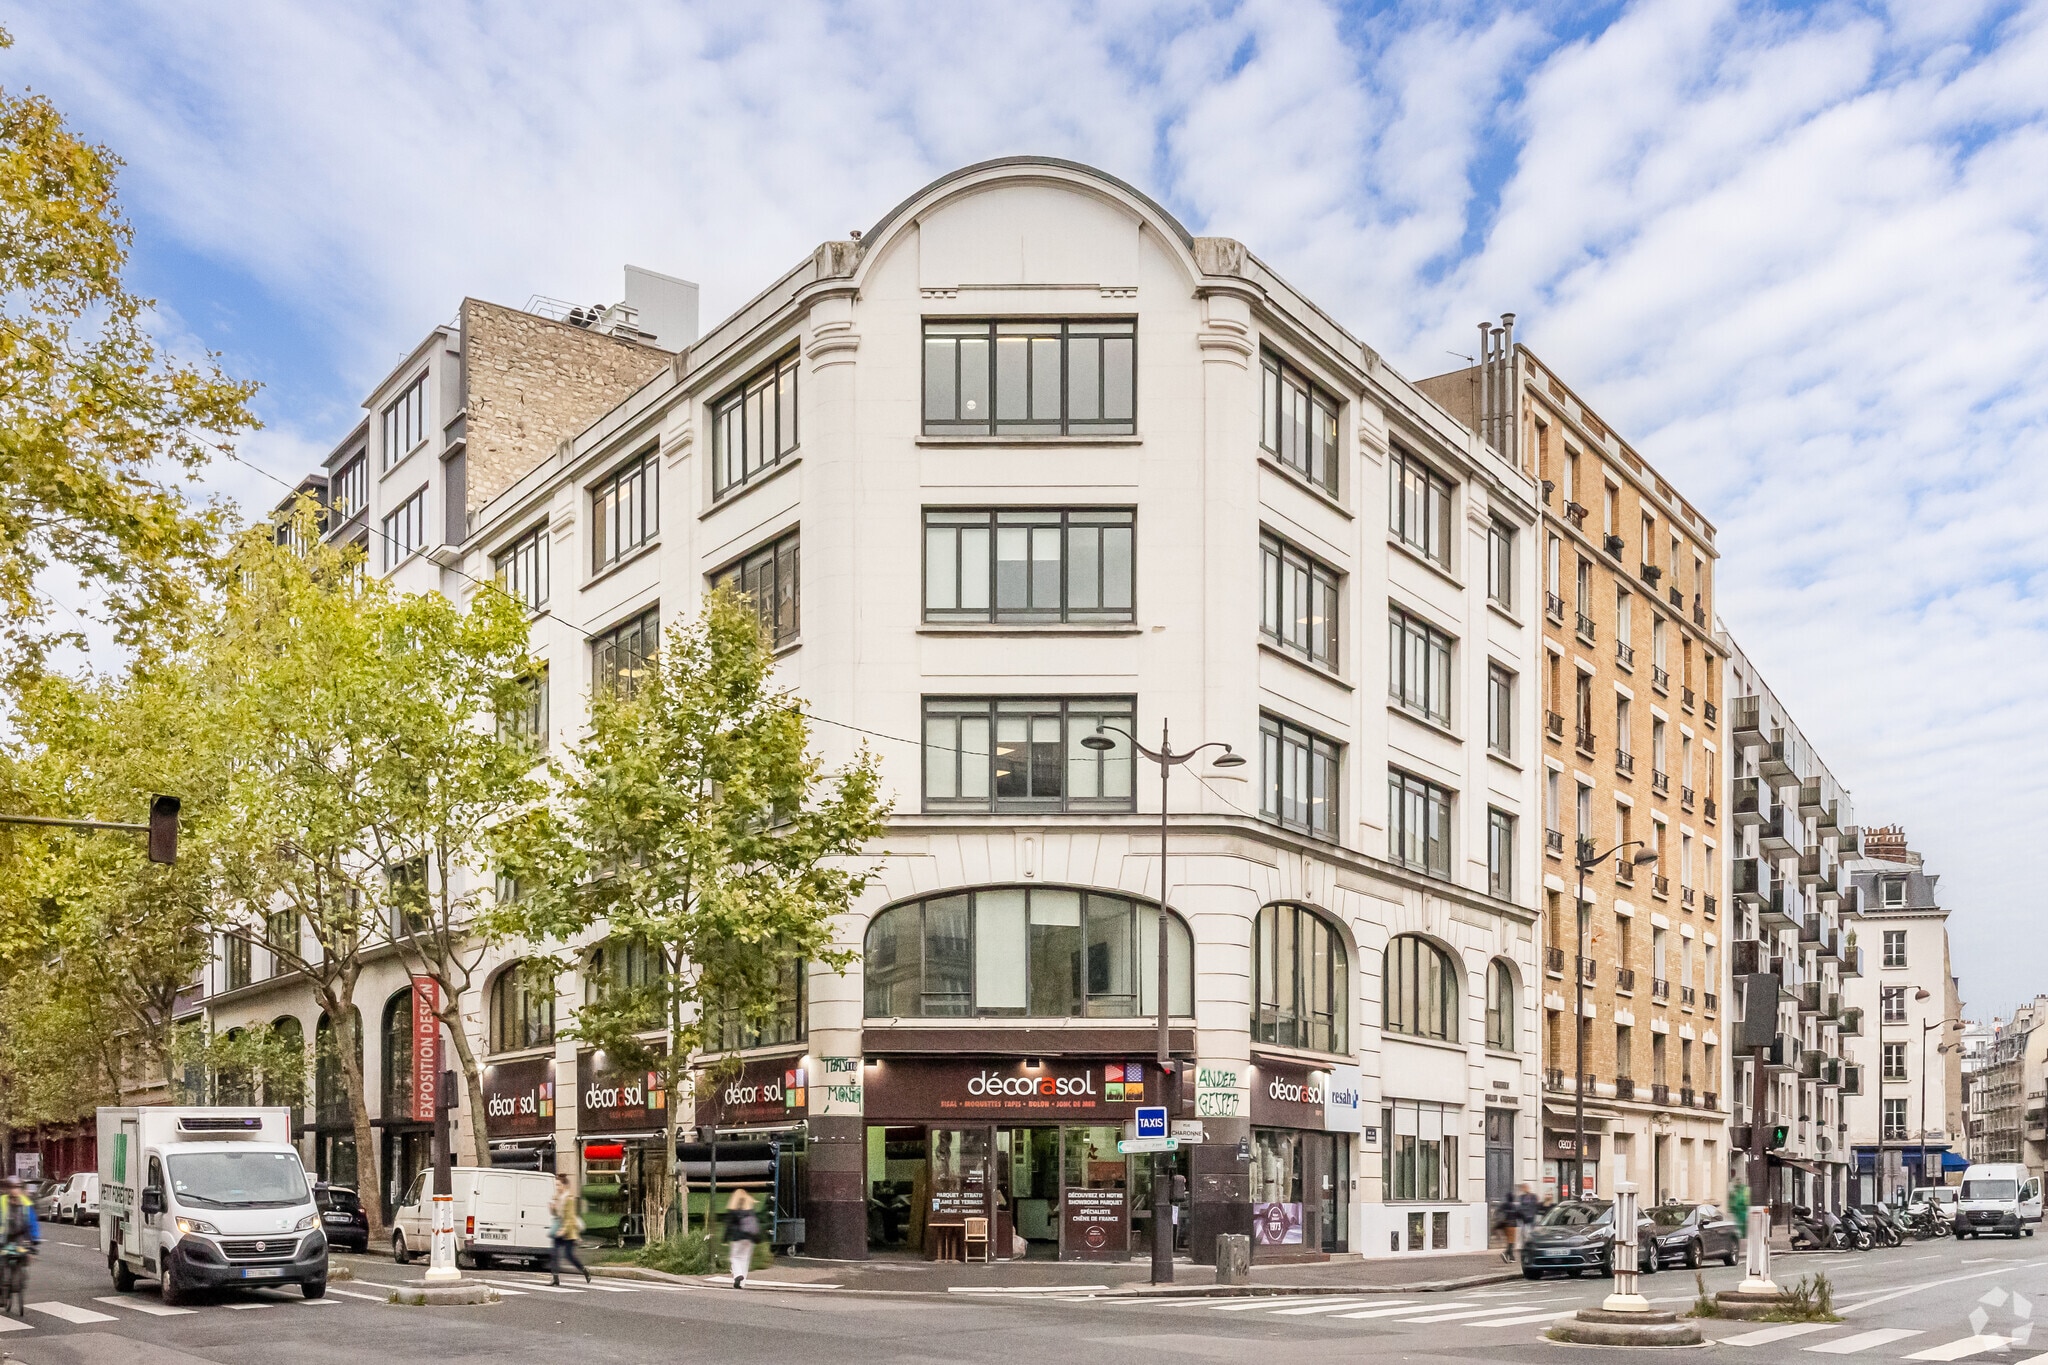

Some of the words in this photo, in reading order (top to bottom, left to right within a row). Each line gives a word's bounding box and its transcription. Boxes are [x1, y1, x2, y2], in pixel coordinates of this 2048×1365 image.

[419, 983, 433, 1033] DESIGN
[420, 1037, 434, 1118] EXPOSITION
[967, 1070, 1097, 1096] décorasol
[1269, 1075, 1324, 1105] décorasol
[488, 1088, 537, 1117] décorasol
[585, 1082, 645, 1110] décorasol
[964, 1100, 1001, 1108] MOQUETTES
[1004, 1100, 1022, 1108] TAPIS
[1331, 1088, 1352, 1105] resah
[1139, 1118, 1164, 1128] TAXIS
[1072, 1214, 1090, 1222] CHÊNE
[1080, 1207, 1111, 1215] SPÉCIALISTE
